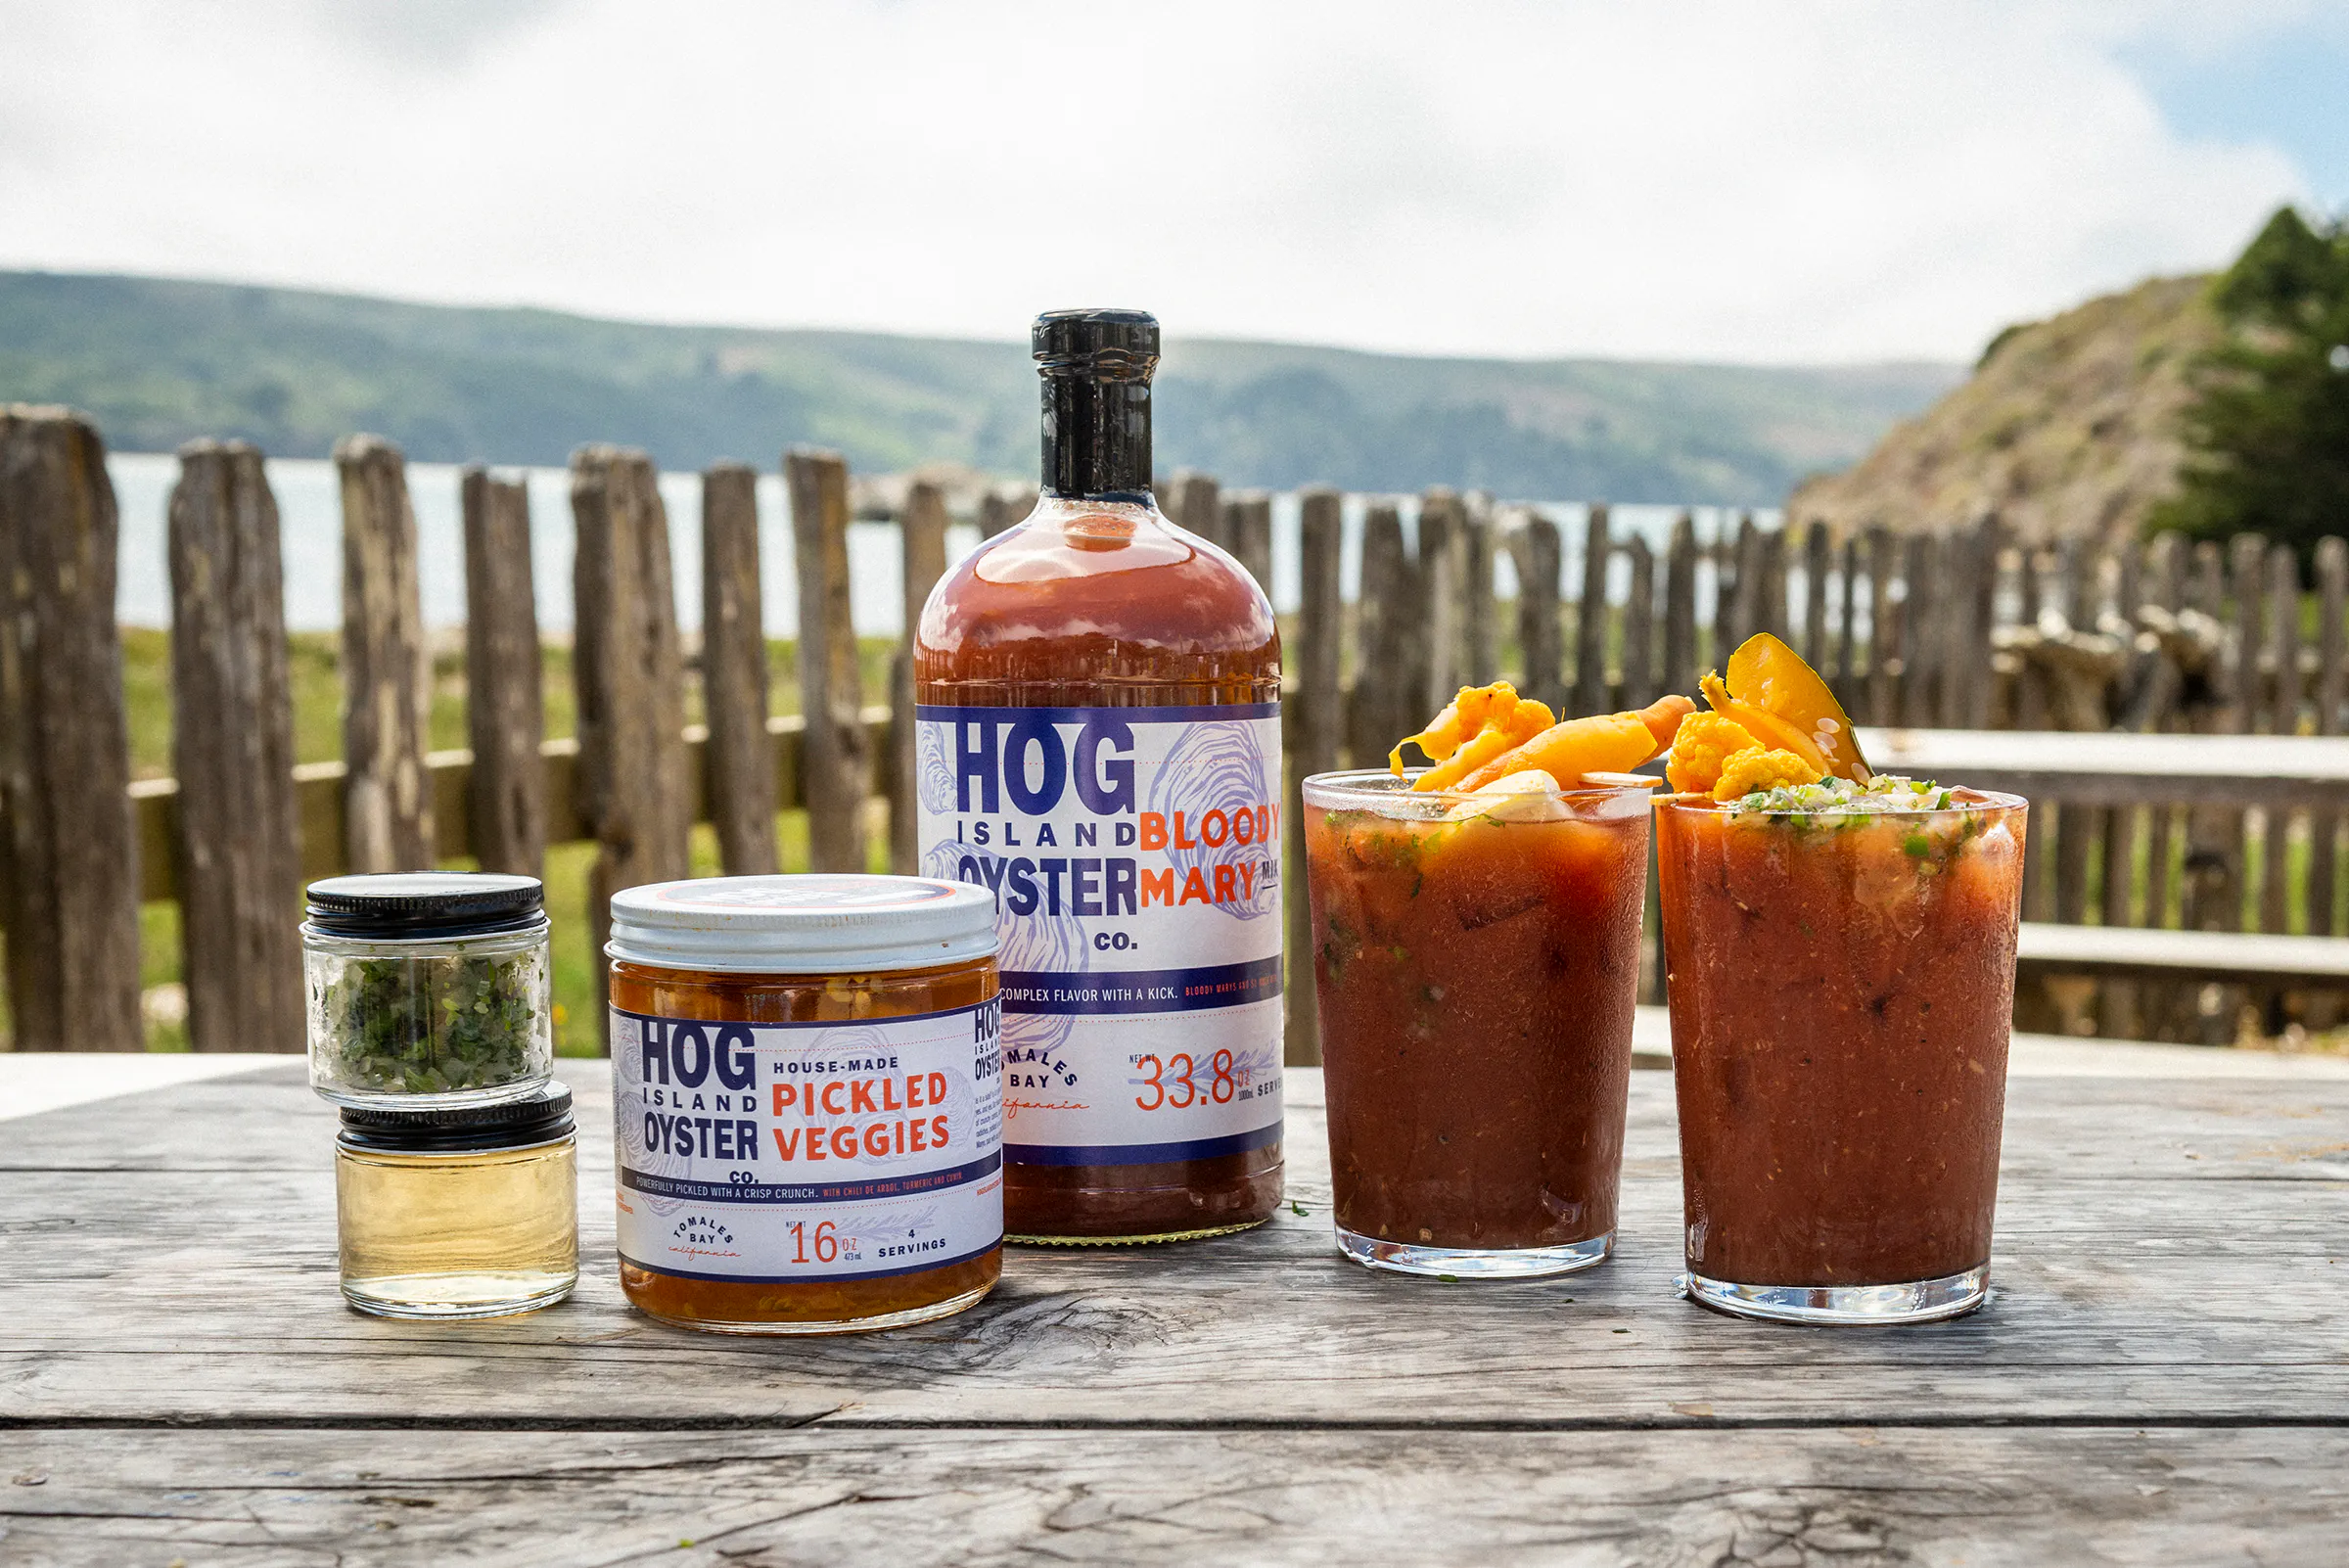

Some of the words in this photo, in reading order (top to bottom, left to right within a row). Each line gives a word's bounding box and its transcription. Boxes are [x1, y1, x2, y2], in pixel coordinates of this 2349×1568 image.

[956, 716, 1135, 815] HOG
[957, 820, 1135, 847] ISLAND
[1140, 803, 1280, 851] BLOODY
[1140, 861, 1257, 908] MARY
[1262, 859, 1278, 880] MIX
[1094, 932, 1138, 950] CO.
[1000, 987, 1049, 1002] COMPLEX
[1054, 988, 1098, 1001] FLAVOR
[1102, 989, 1131, 1001] WITH
[1135, 989, 1144, 1000] A
[1148, 987, 1178, 999] KICK.
[1185, 985, 1213, 996] BLOODY
[1216, 982, 1236, 993] MARYS
[642, 1020, 757, 1091] HOG
[773, 1057, 898, 1074] HOUSE-MADE
[1000, 1048, 1078, 1086] MALES
[1128, 1054, 1142, 1063] NET
[1010, 1074, 1049, 1087] BAY
[1135, 1048, 1235, 1111] 33.8
[1237, 1069, 1250, 1087] OZ
[643, 1087, 757, 1112] ISLAND
[772, 1072, 946, 1116] PICKLED
[1001, 1097, 1089, 1120] ifornia
[644, 1111, 759, 1160] OYSTER
[772, 1115, 949, 1162] VEGGIES
[636, 1176, 673, 1192] POWERFULLY
[676, 1184, 708, 1196] PICKLED
[711, 1187, 733, 1198] WITH
[735, 1188, 741, 1198] A
[744, 1188, 771, 1199] CRISP
[775, 1188, 818, 1199] CRUNCH.
[822, 1187, 841, 1197] WITH
[865, 1184, 874, 1194] DE
[902, 1177, 933, 1190] TURMERIC
[934, 1176, 944, 1185] AND
[729, 1171, 760, 1184] CO.
[673, 1217, 734, 1243] TOMALES
[689, 1233, 715, 1244] BAY
[790, 1221, 838, 1264] 16
[842, 1237, 857, 1252] OZ
[908, 1229, 916, 1238] 4
[668, 1245, 742, 1262] california
[878, 1238, 946, 1258] SERVINGS
